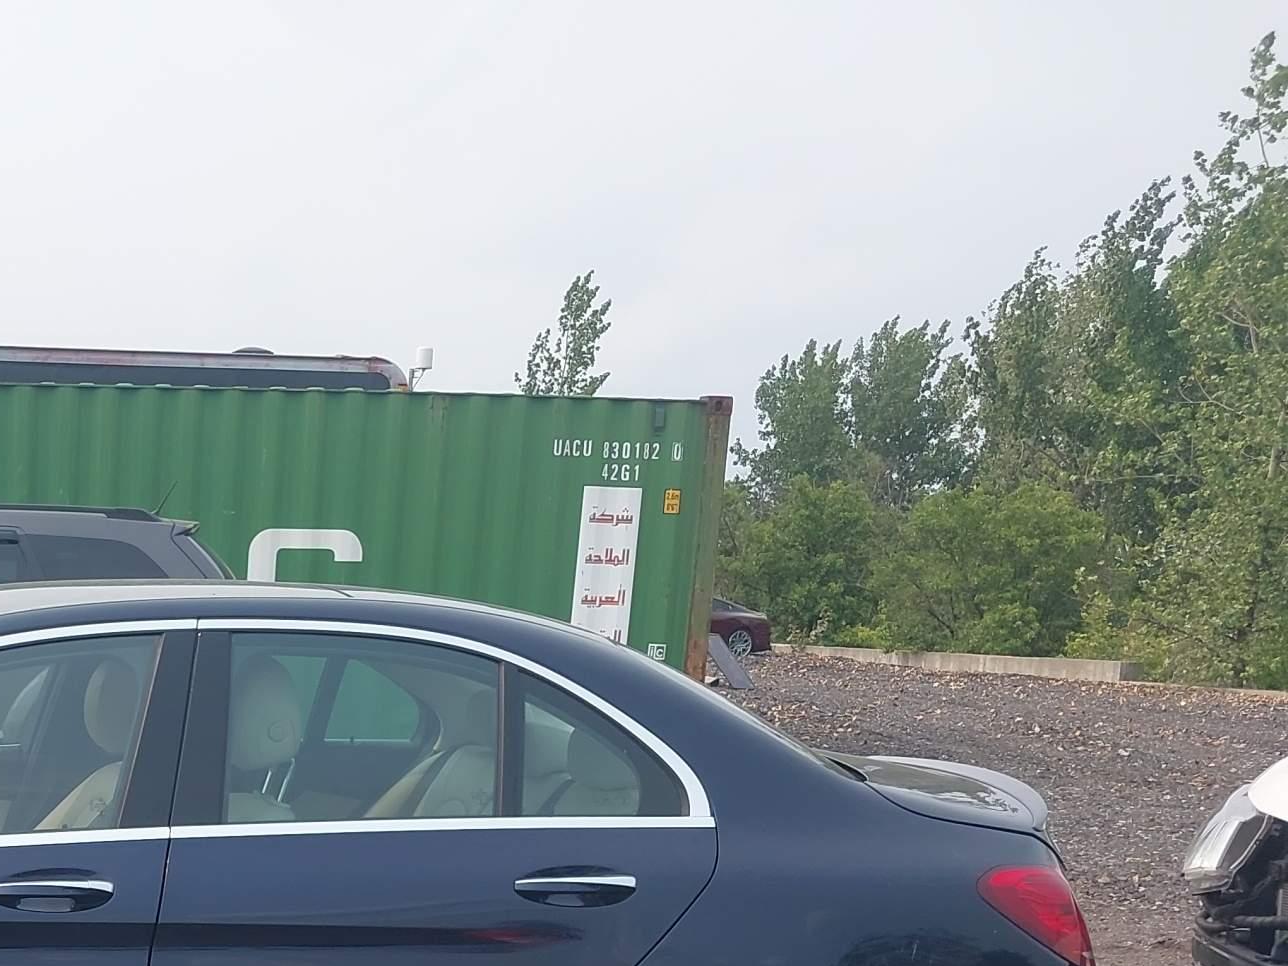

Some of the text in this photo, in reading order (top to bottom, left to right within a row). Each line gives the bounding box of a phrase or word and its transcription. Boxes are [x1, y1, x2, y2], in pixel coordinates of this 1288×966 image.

[553, 439, 592, 457] UACU
[603, 441, 660, 460] 830182
[602, 463, 640, 481] 42G1
[588, 506, 633, 527] شركة
[584, 547, 630, 566] الملاحة
[580, 584, 626, 608] العربية
